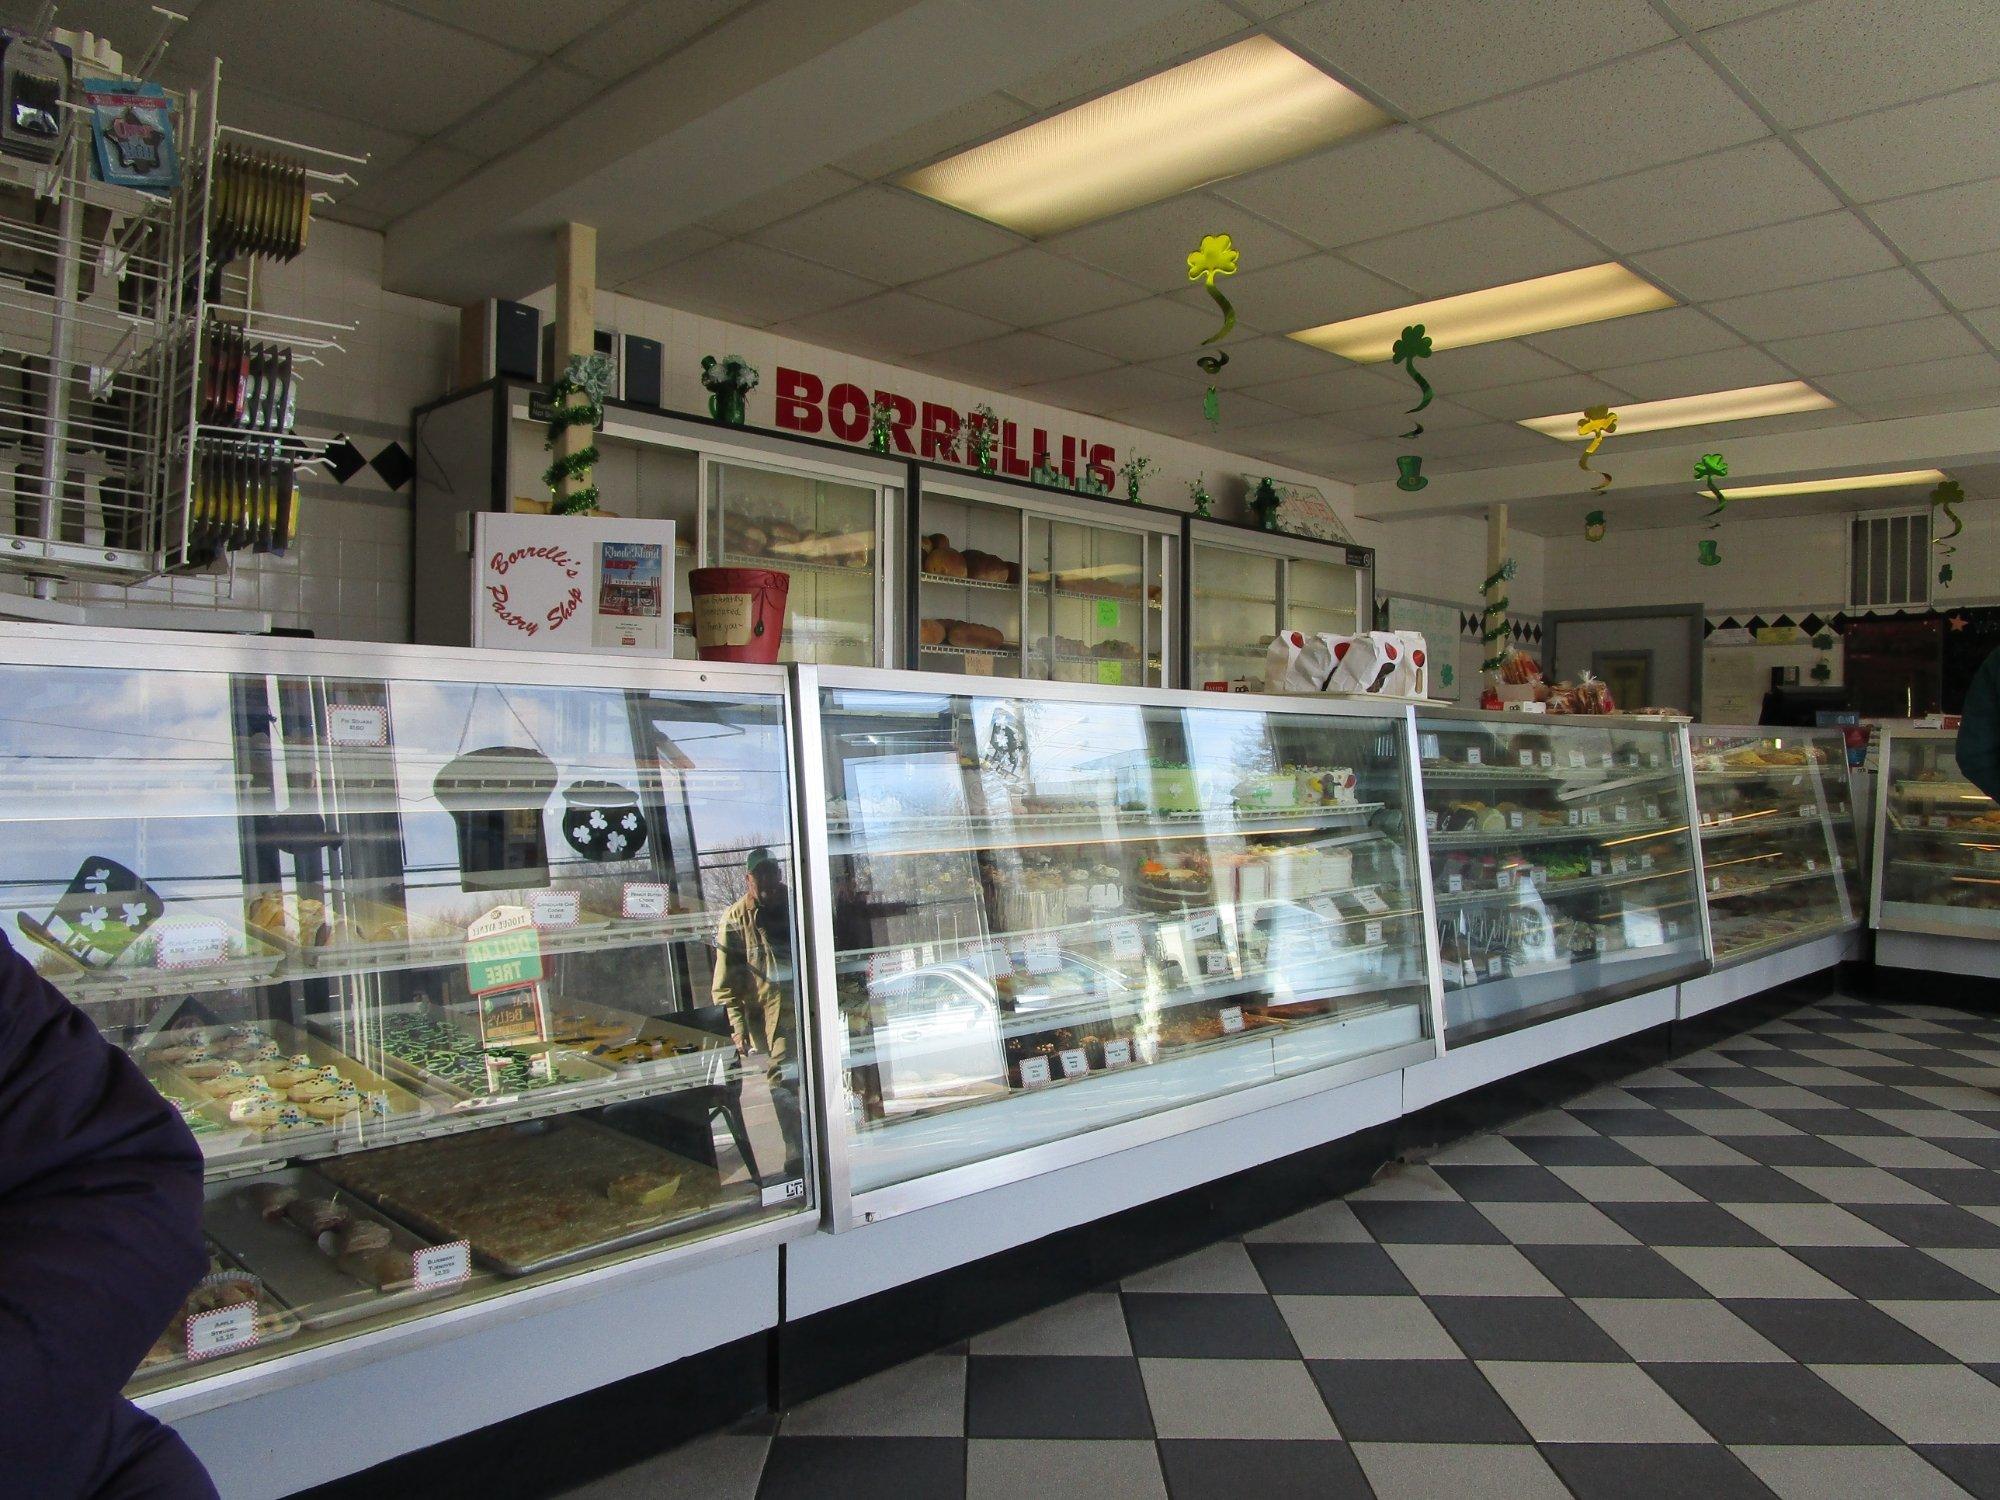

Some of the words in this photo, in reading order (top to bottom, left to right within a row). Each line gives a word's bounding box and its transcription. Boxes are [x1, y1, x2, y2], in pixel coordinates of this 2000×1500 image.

[775, 366, 1116, 494] BORRELLI'S
[490, 545, 581, 579] Borrelli's
[486, 584, 540, 637] Pastry
[546, 587, 583, 631] Shop
